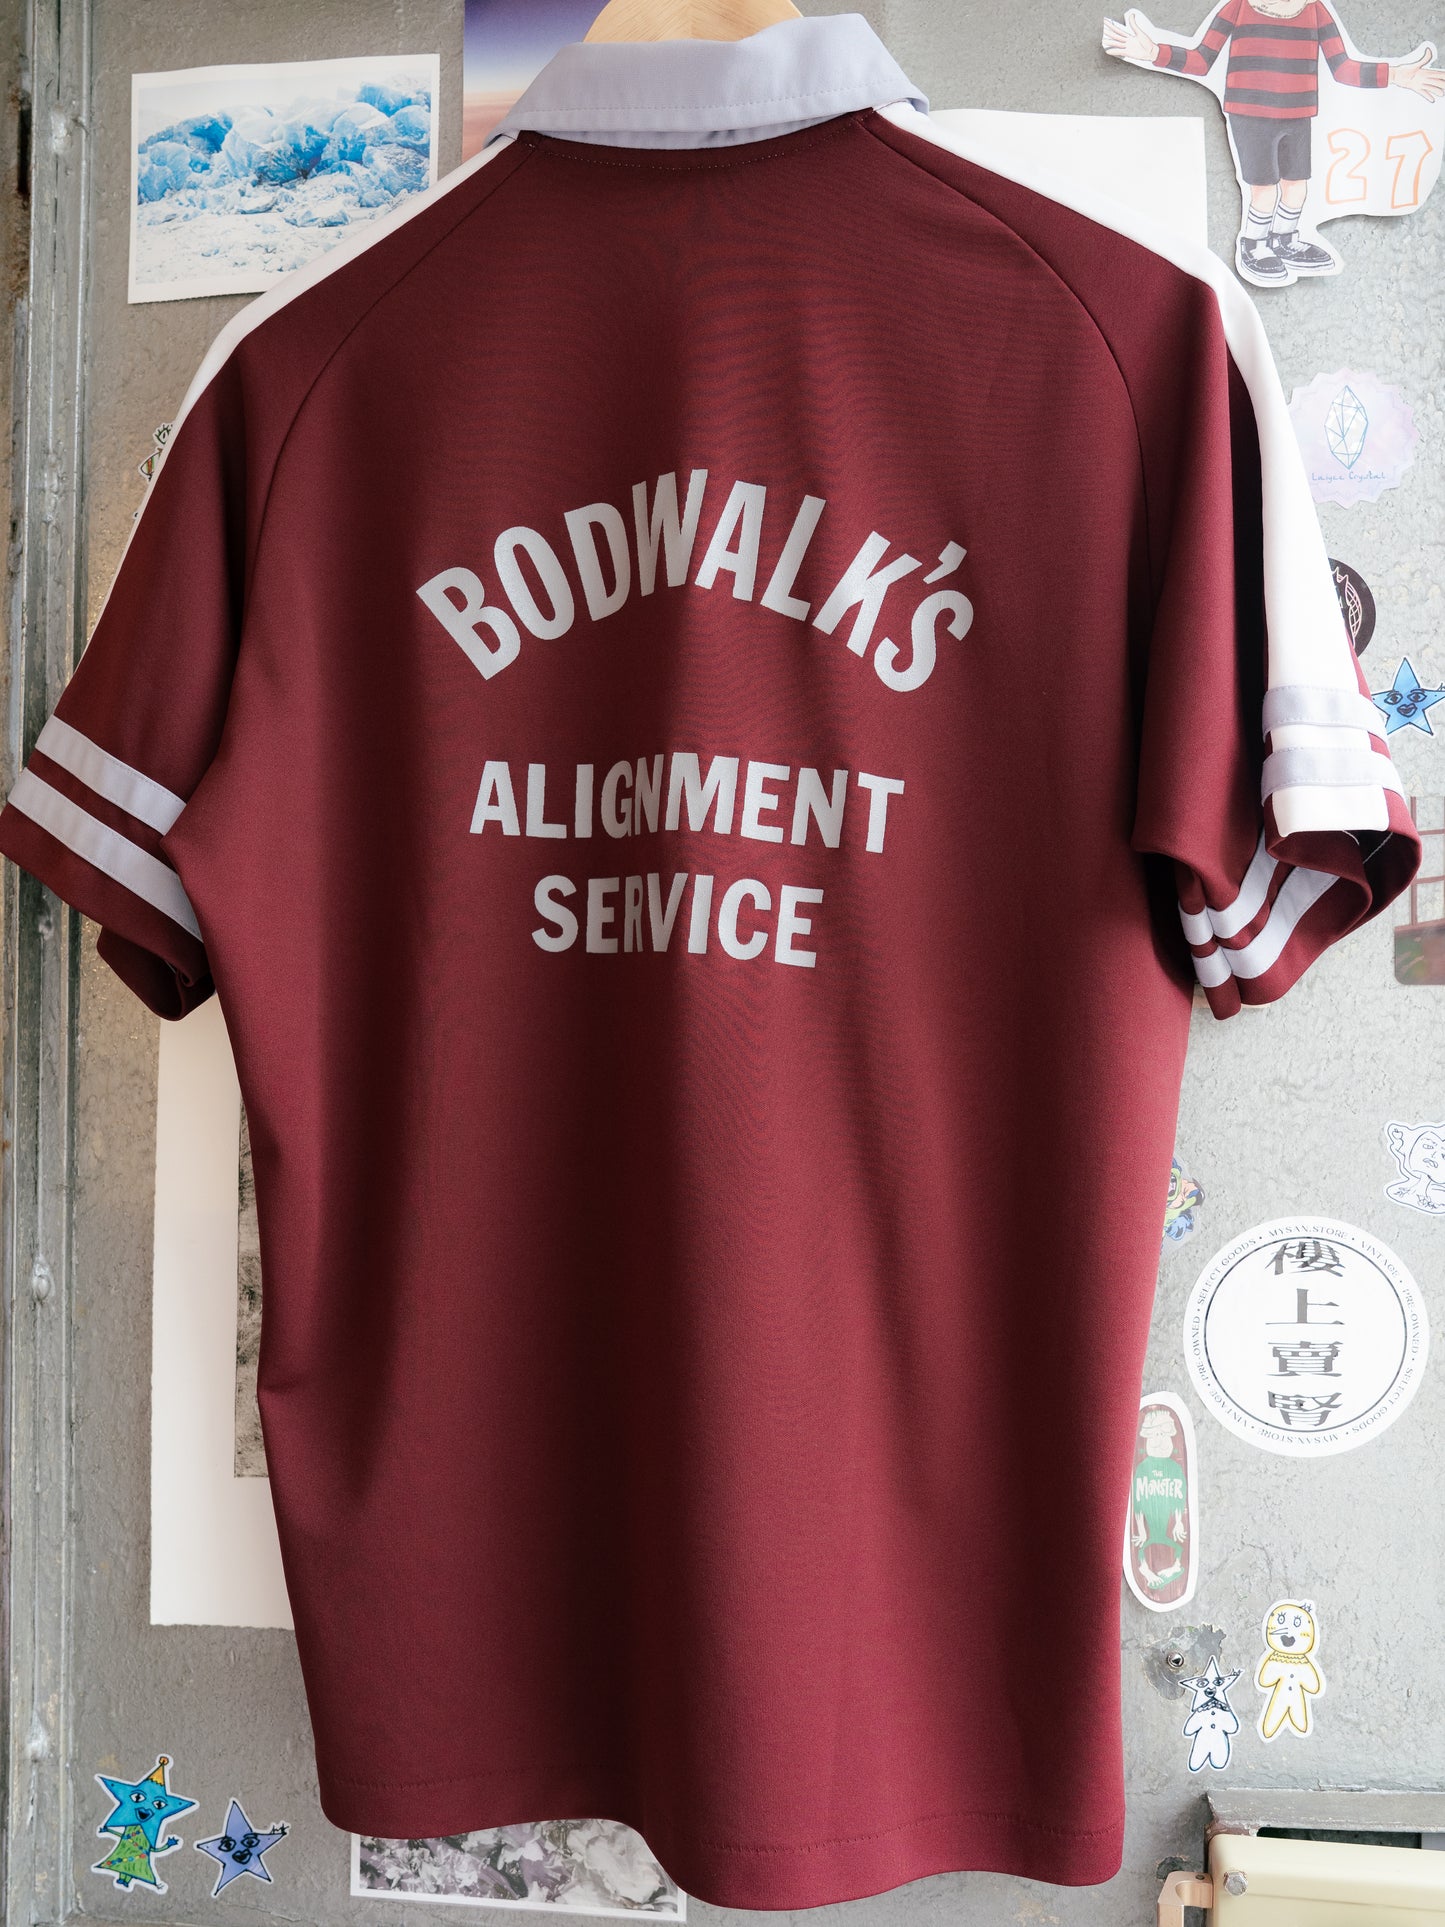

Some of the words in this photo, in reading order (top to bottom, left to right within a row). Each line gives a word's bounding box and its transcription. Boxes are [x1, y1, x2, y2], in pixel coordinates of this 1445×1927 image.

[1325, 128, 1434, 210] 27
[415, 468, 975, 693] BODWALK'S
[469, 752, 905, 854] ALIGNMENT
[531, 872, 825, 968] SERVICE
[1221, 1238, 1257, 1266] GOODS
[1361, 1241, 1400, 1279] VINTAGE
[1197, 1267, 1221, 1305] SELECT
[1402, 1288, 1420, 1354] PRE-OWNED
[1191, 1316, 1209, 1383] PRE-OWNED
[1388, 1367, 1413, 1405] SELECT
[1209, 1389, 1247, 1427] VINTAGE
[1351, 1406, 1388, 1433] GOODS
[1136, 1476, 1183, 1502] MONSTER
